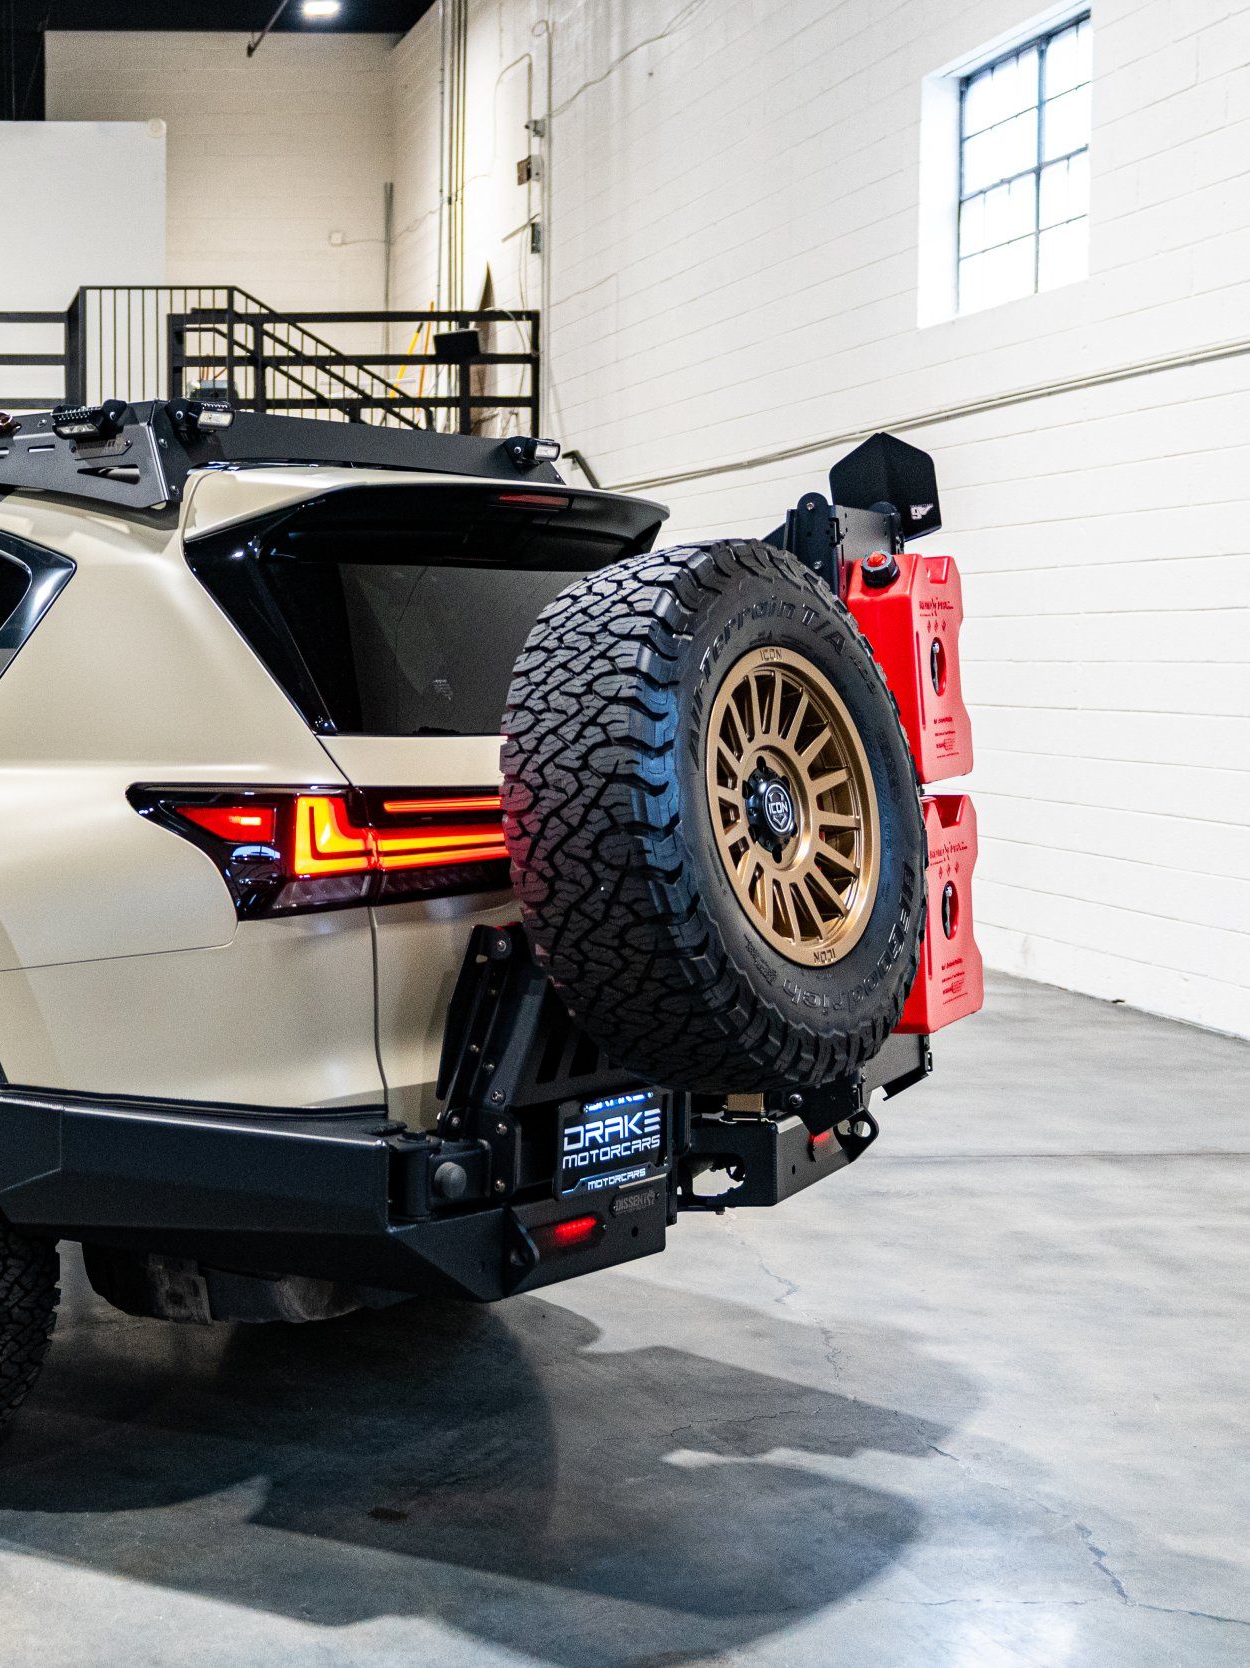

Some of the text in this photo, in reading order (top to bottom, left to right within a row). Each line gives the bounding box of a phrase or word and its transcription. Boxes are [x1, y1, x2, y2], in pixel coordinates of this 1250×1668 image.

[759, 649, 783, 661] ICON
[688, 595, 796, 771] All-Terrain
[802, 603, 847, 656] T/A
[768, 801, 789, 815] ICON
[813, 949, 836, 964] ICON
[563, 1108, 662, 1152] DRAKE
[562, 1134, 661, 1170] MOTORCARS
[588, 1168, 646, 1191] MOTORCARS
